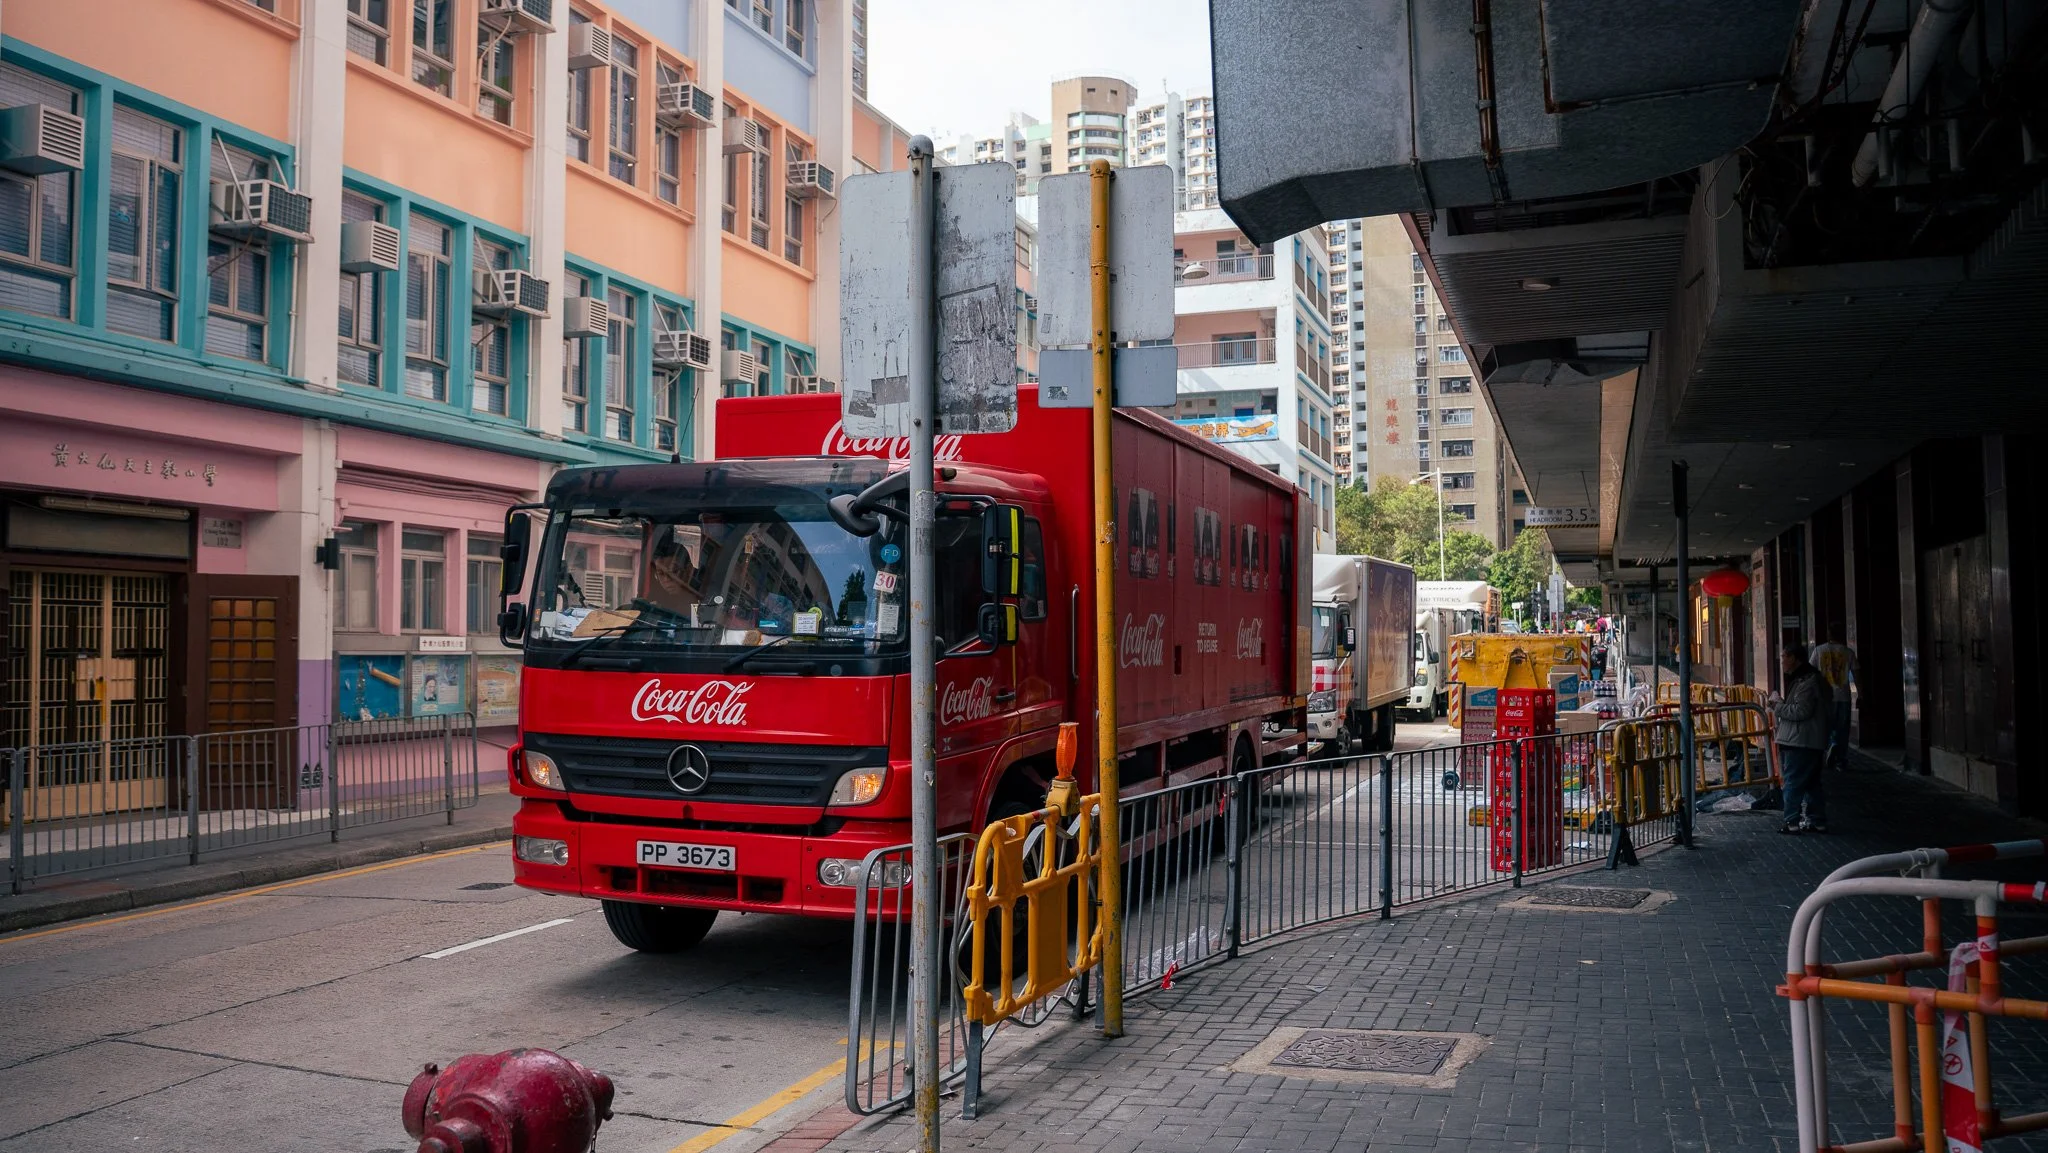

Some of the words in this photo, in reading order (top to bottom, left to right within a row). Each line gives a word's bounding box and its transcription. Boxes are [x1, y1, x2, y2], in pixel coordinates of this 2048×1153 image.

[1565, 508, 1588, 522] 3.5
[876, 573, 895, 589] 30
[1120, 612, 1165, 669] Coca-Cola
[1198, 622, 1217, 636] RETURN
[1237, 617, 1263, 659] Coca-Cola
[1197, 640, 1204, 653] TO
[631, 678, 756, 725] Coca-Cola
[941, 676, 994, 726] Coca-Cola
[642, 843, 667, 862] PP
[677, 846, 730, 867] 3673
